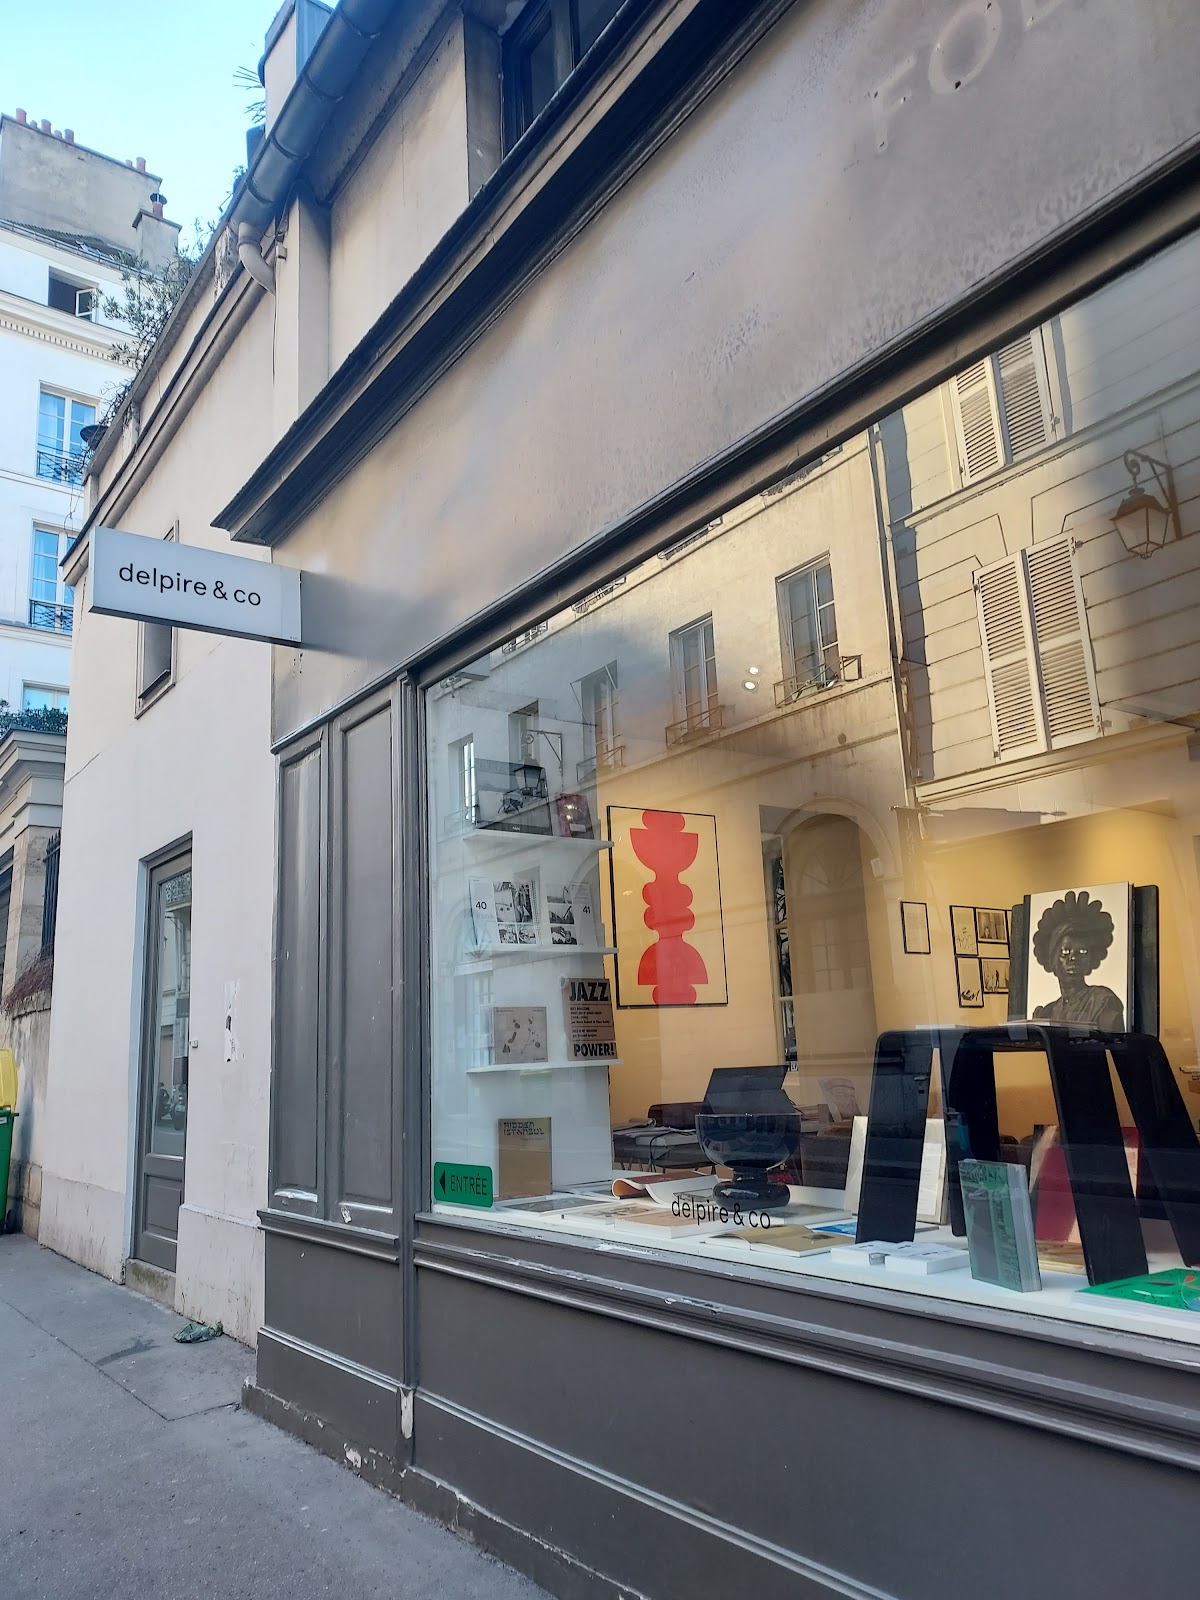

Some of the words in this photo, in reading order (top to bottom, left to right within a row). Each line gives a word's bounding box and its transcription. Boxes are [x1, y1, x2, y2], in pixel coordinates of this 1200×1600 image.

[868, 0, 1072, 153] FO
[118, 562, 207, 596] delpire
[212, 580, 228, 601] &
[233, 588, 262, 606] co
[475, 901, 487, 910] 40
[582, 905, 591, 914] 41
[569, 981, 609, 1002] JAZZ
[573, 1042, 615, 1057] POWER!
[450, 1173, 488, 1196] ENTRÉE
[671, 1195, 729, 1225] delpire
[733, 1202, 745, 1225] &
[748, 1210, 772, 1230] co
